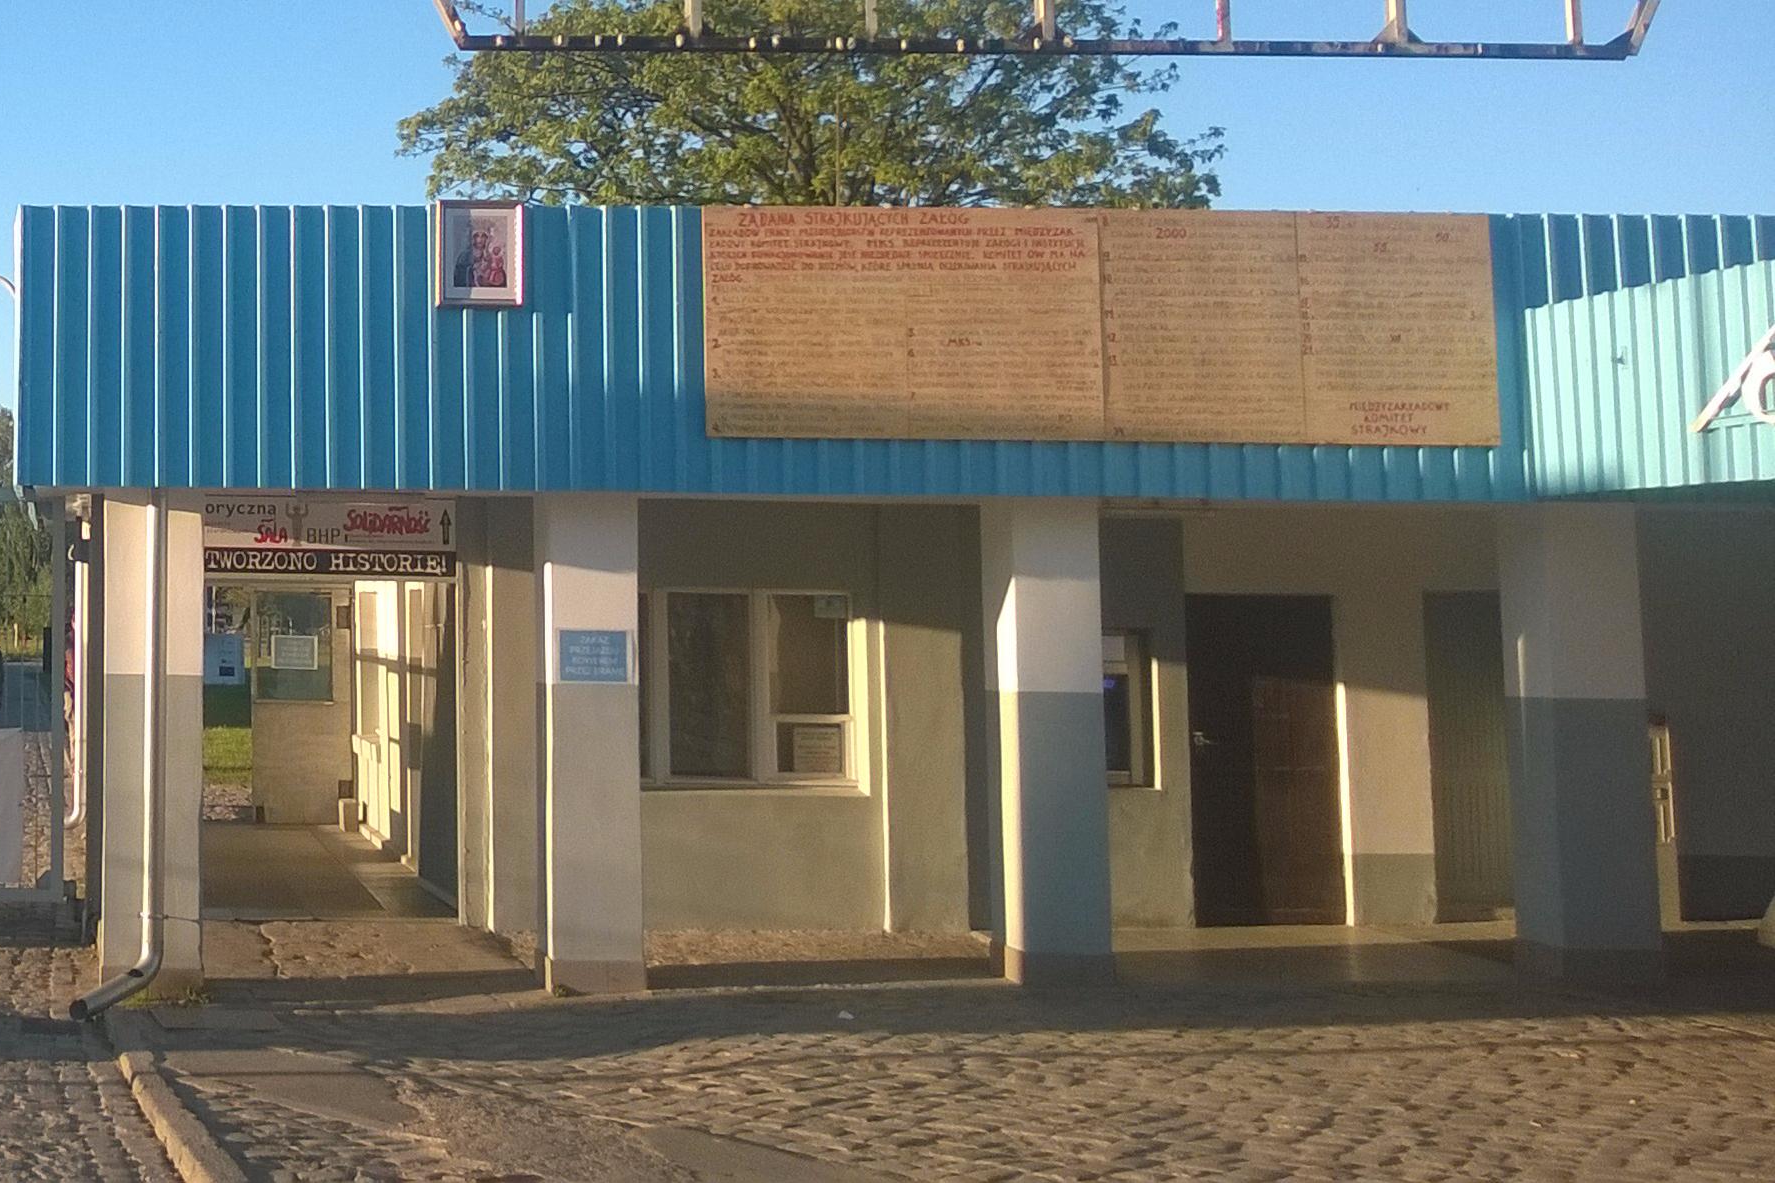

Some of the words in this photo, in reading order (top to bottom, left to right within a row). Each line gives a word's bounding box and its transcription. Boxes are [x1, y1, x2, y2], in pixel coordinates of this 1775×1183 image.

[1155, 227, 1187, 239] 2000
[205, 503, 277, 518] oryczna
[307, 528, 341, 544] BHP
[205, 551, 318, 572] TWORZONO
